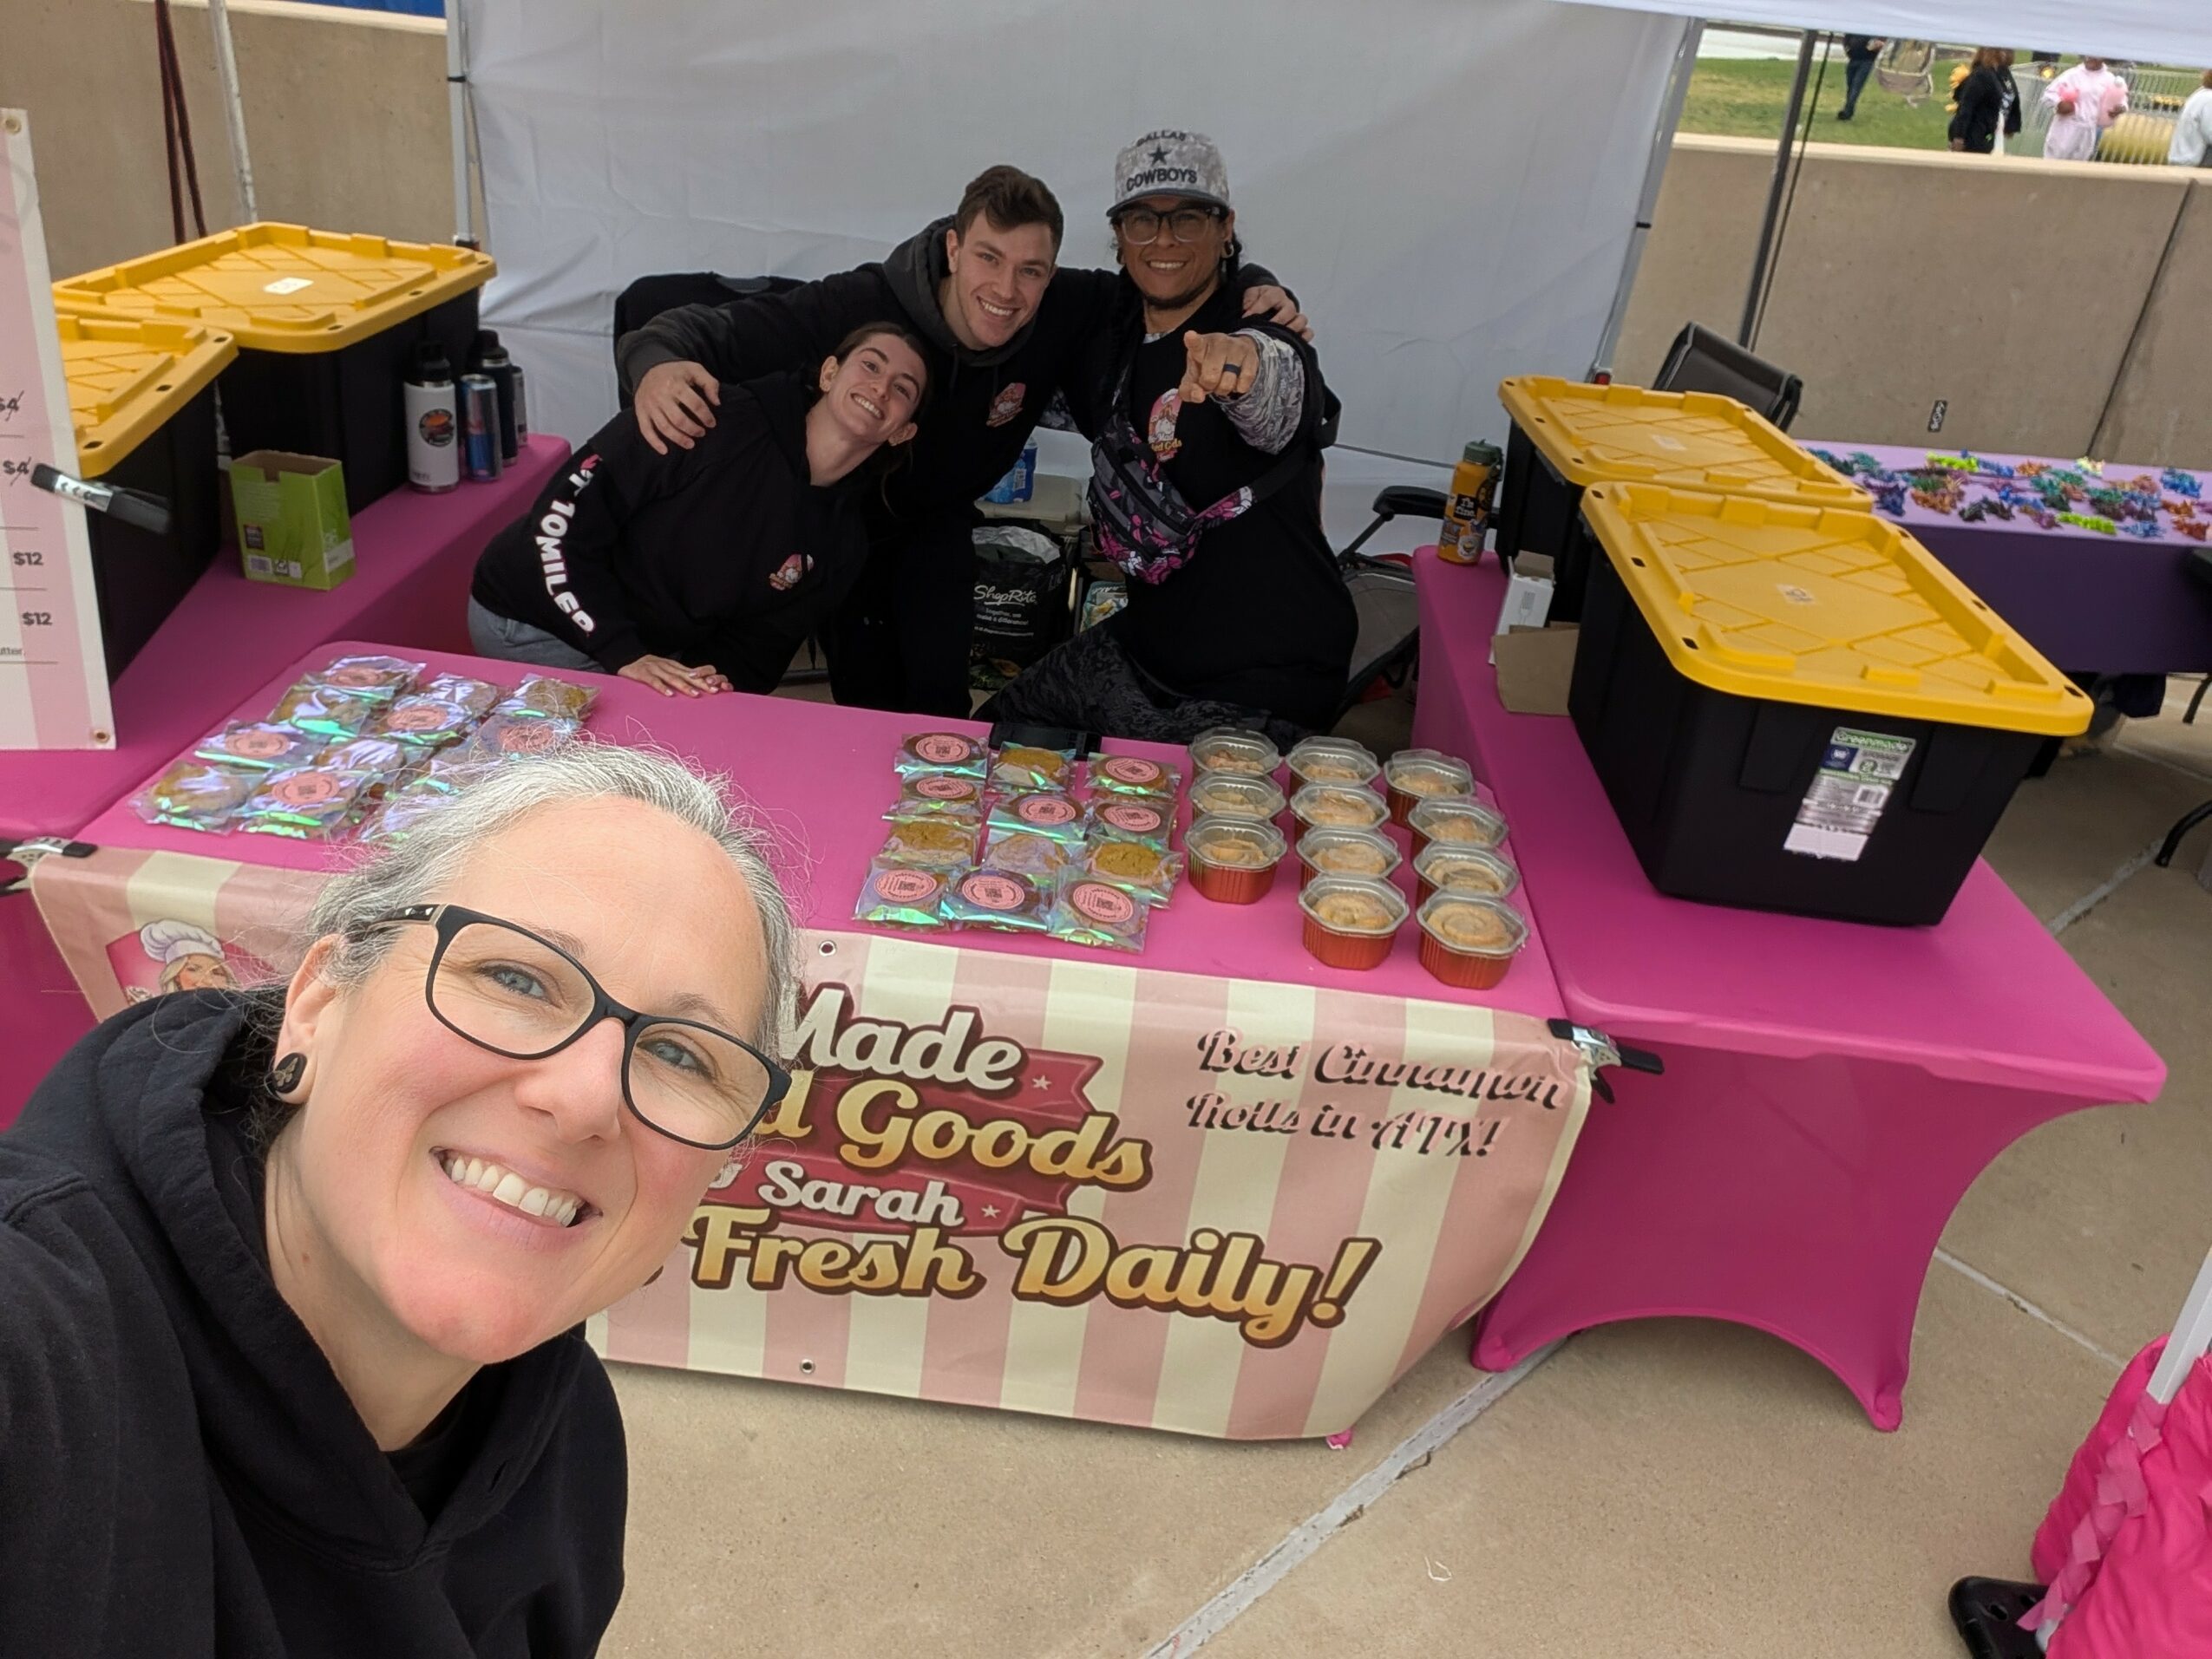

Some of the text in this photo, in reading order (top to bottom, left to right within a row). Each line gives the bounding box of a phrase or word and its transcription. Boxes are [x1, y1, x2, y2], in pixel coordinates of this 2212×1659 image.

[1126, 167, 1198, 192] COWBOYS
[13, 552, 43, 566] $12
[22, 611, 53, 626] $12
[973, 585, 1037, 606] ShopRite
[1197, 1026, 1567, 1109] Best Cinnamon
[833, 1075, 1148, 1183] Goods
[1186, 1091, 1509, 1156] Rolls in ATX!
[757, 1159, 965, 1228] Sarah
[684, 1205, 1382, 1346] Fresh Daily!
